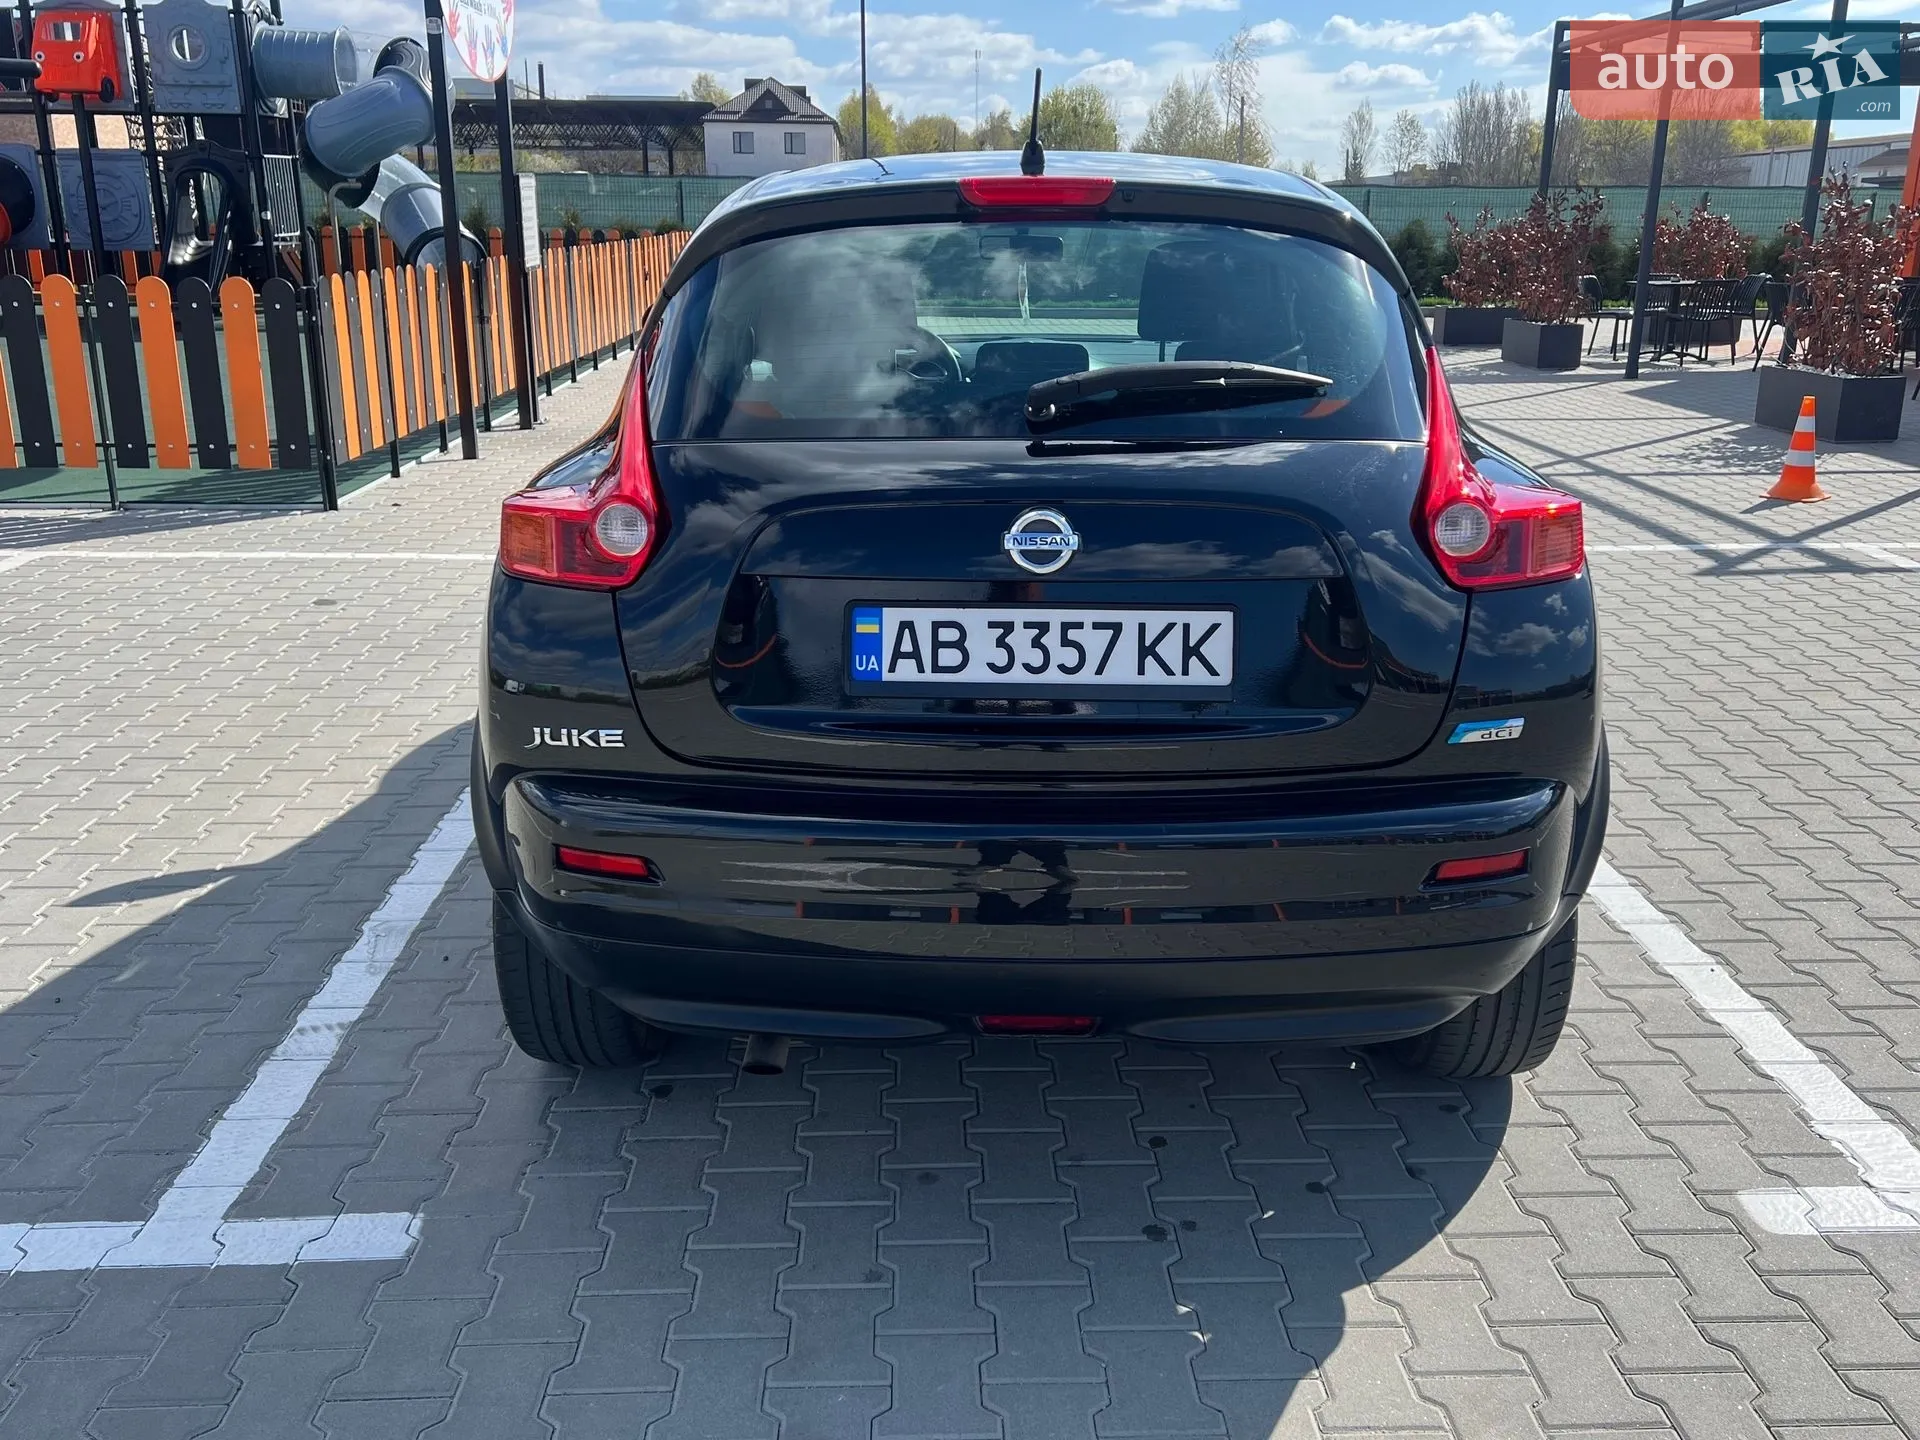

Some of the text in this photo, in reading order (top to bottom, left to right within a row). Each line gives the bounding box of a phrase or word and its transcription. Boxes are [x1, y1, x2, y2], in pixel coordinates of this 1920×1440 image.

[1012, 536, 1070, 547] NISSAN
[887, 620, 1223, 677] AB 3357 KK
[855, 655, 879, 671] UA
[523, 727, 626, 750] JUKE
[1480, 728, 1513, 740] dCi
